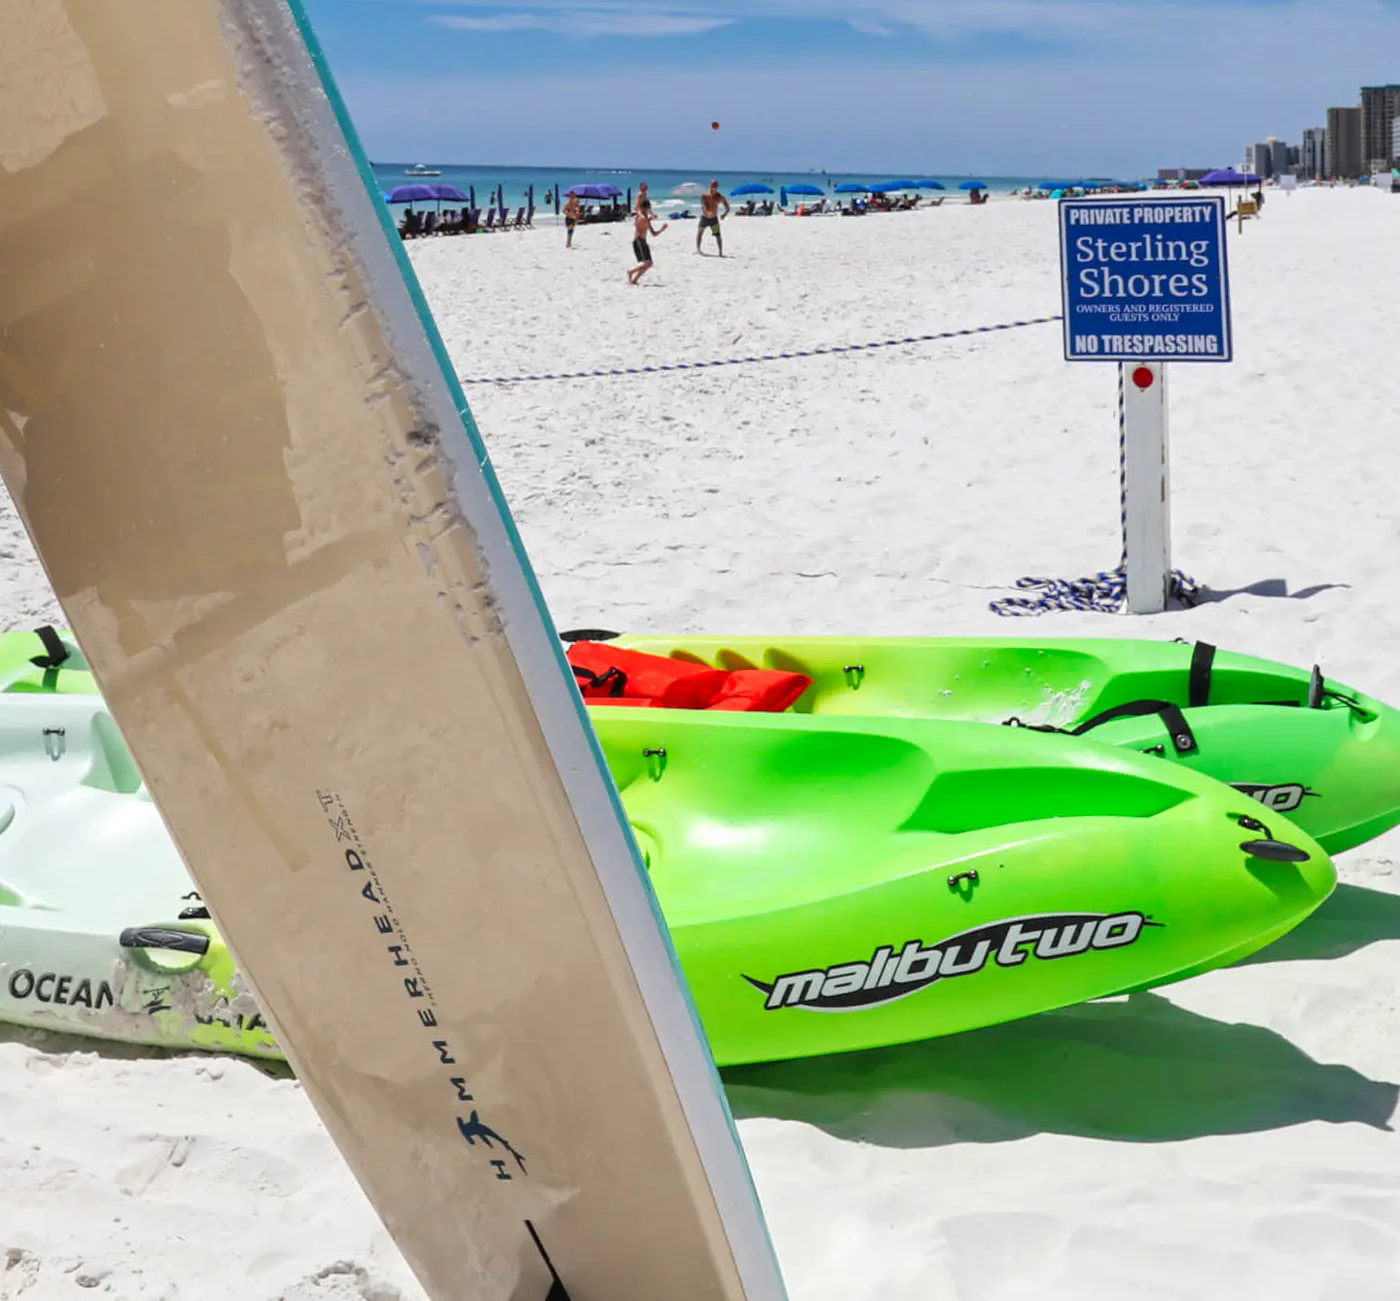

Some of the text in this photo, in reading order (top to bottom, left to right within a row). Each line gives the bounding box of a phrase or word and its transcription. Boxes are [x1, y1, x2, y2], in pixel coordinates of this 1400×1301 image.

[1070, 206, 1212, 225] PRIVATE PROPERTY
[1076, 234, 1210, 267] Sterling
[1079, 267, 1208, 298] Shores
[1076, 304, 1214, 313] OWNERS AND REGISTERED
[1109, 313, 1181, 322] GUESTS ONLY
[1075, 334, 1218, 354] NO TRESPASSING
[8, 968, 114, 1009] OCEAN
